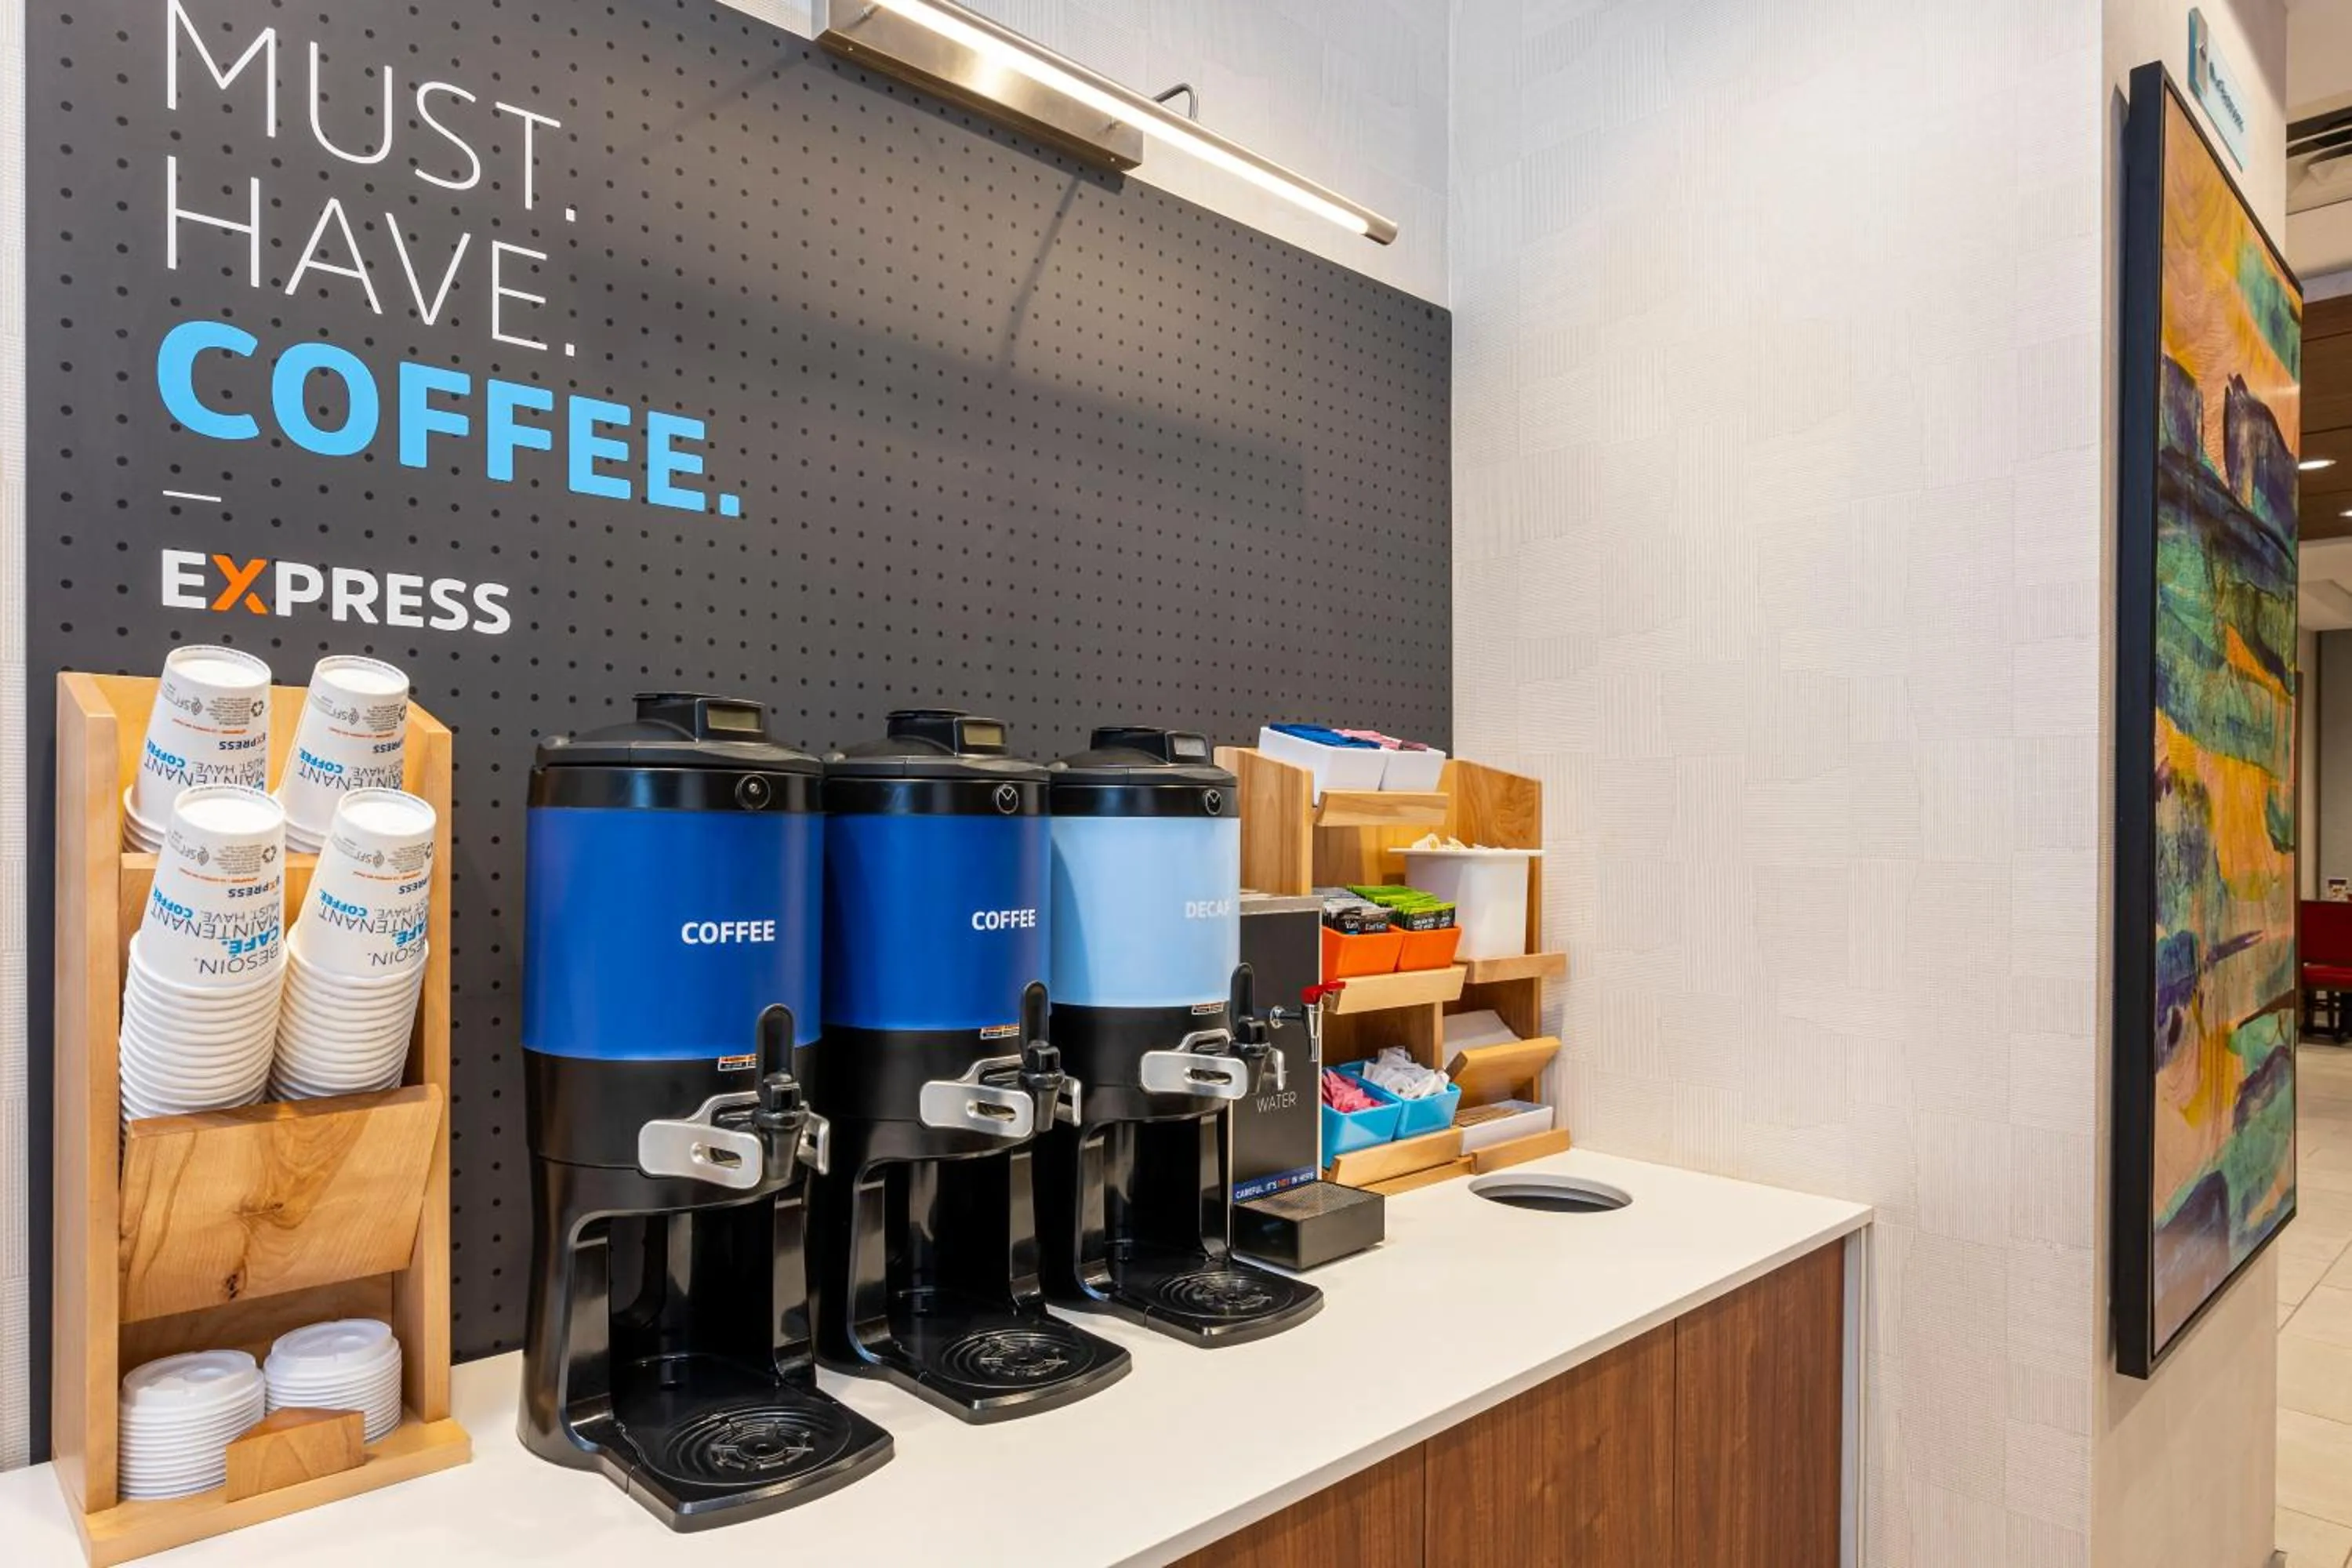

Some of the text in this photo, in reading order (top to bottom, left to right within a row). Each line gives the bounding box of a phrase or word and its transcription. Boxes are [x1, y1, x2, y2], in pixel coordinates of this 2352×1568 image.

[167, 0, 576, 222] MUST.
[167, 155, 575, 357] HAVE.
[156, 321, 740, 517] COFFEE.
[162, 549, 511, 634] EXPRESS
[971, 908, 1036, 931] COFFEE
[1184, 898, 1231, 919] DECAF
[392, 922, 427, 948] AFÉ.
[681, 919, 776, 946] COFFEE
[194, 942, 279, 974] BESOIN.
[367, 939, 426, 967] ESOIN.
[1255, 1091, 1298, 1113] WATER
